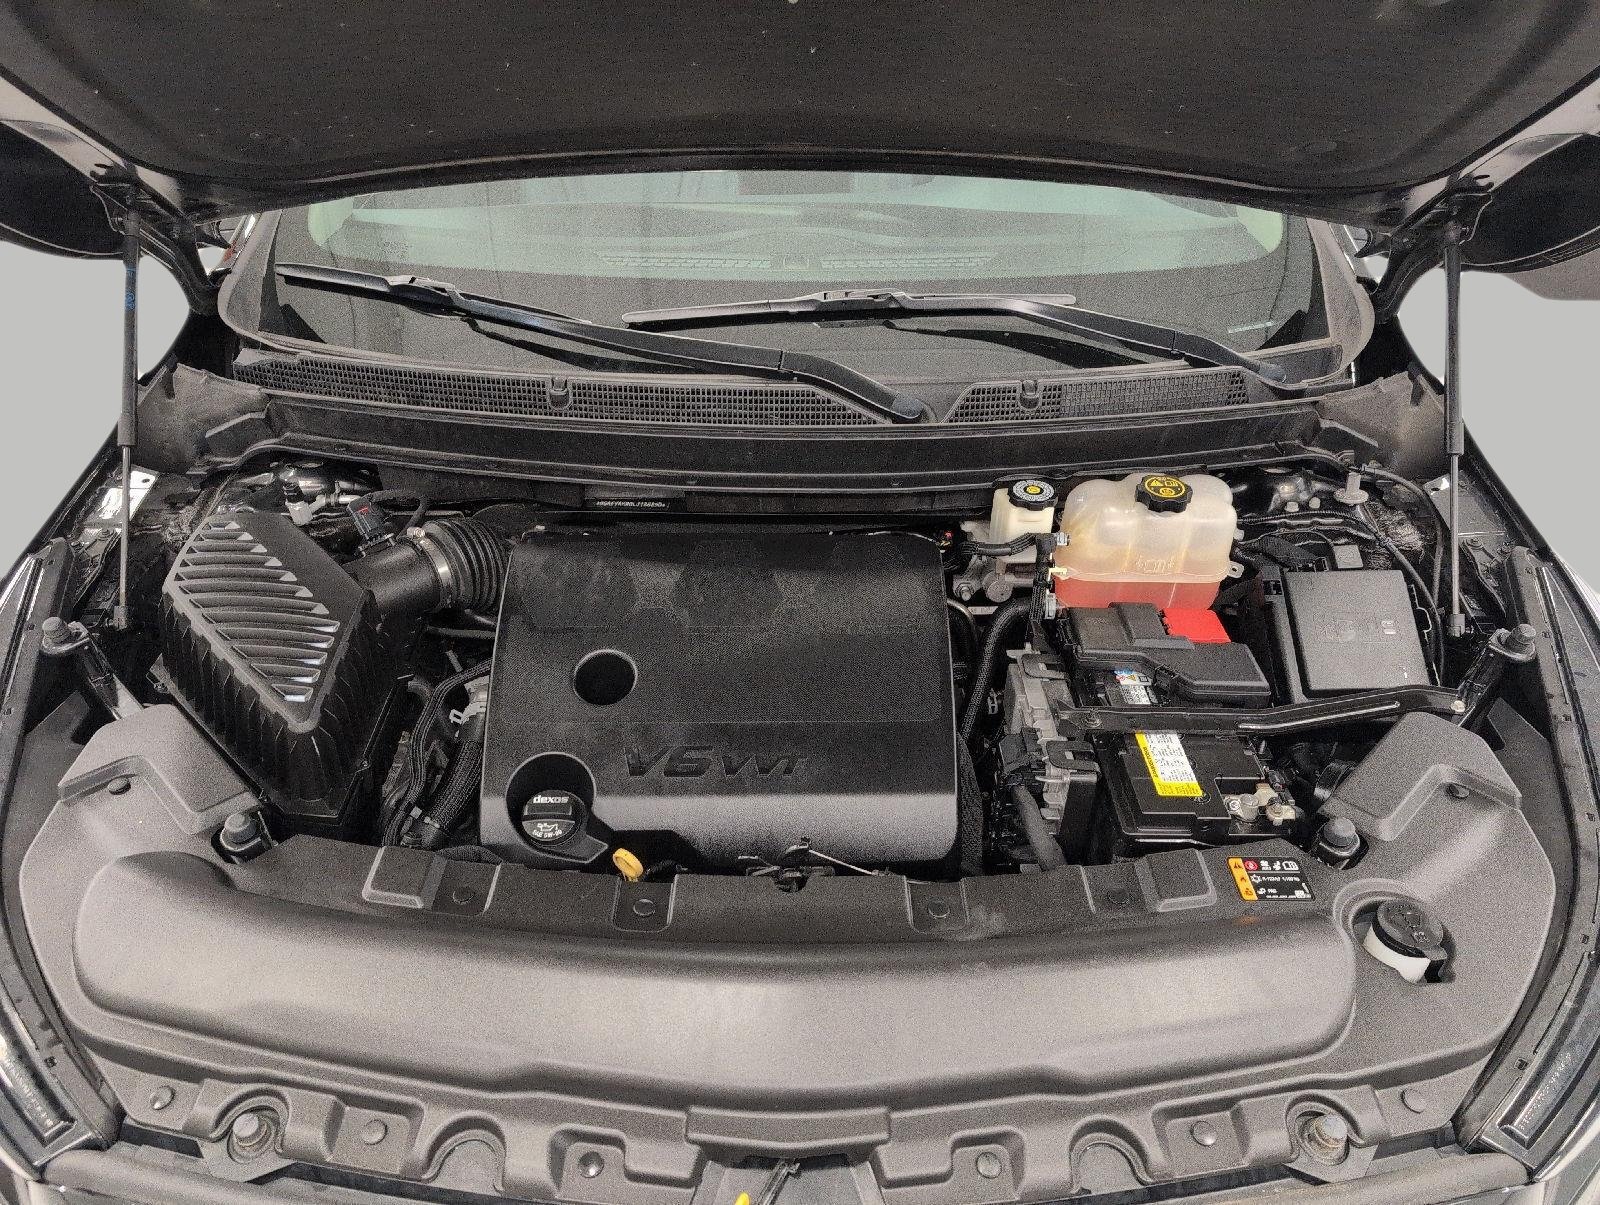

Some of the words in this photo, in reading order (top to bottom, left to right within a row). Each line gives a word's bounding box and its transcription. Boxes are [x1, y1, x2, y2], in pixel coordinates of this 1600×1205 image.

[623, 745, 714, 778] V6
[720, 753, 809, 779] VVT
[532, 795, 569, 803] dexos
